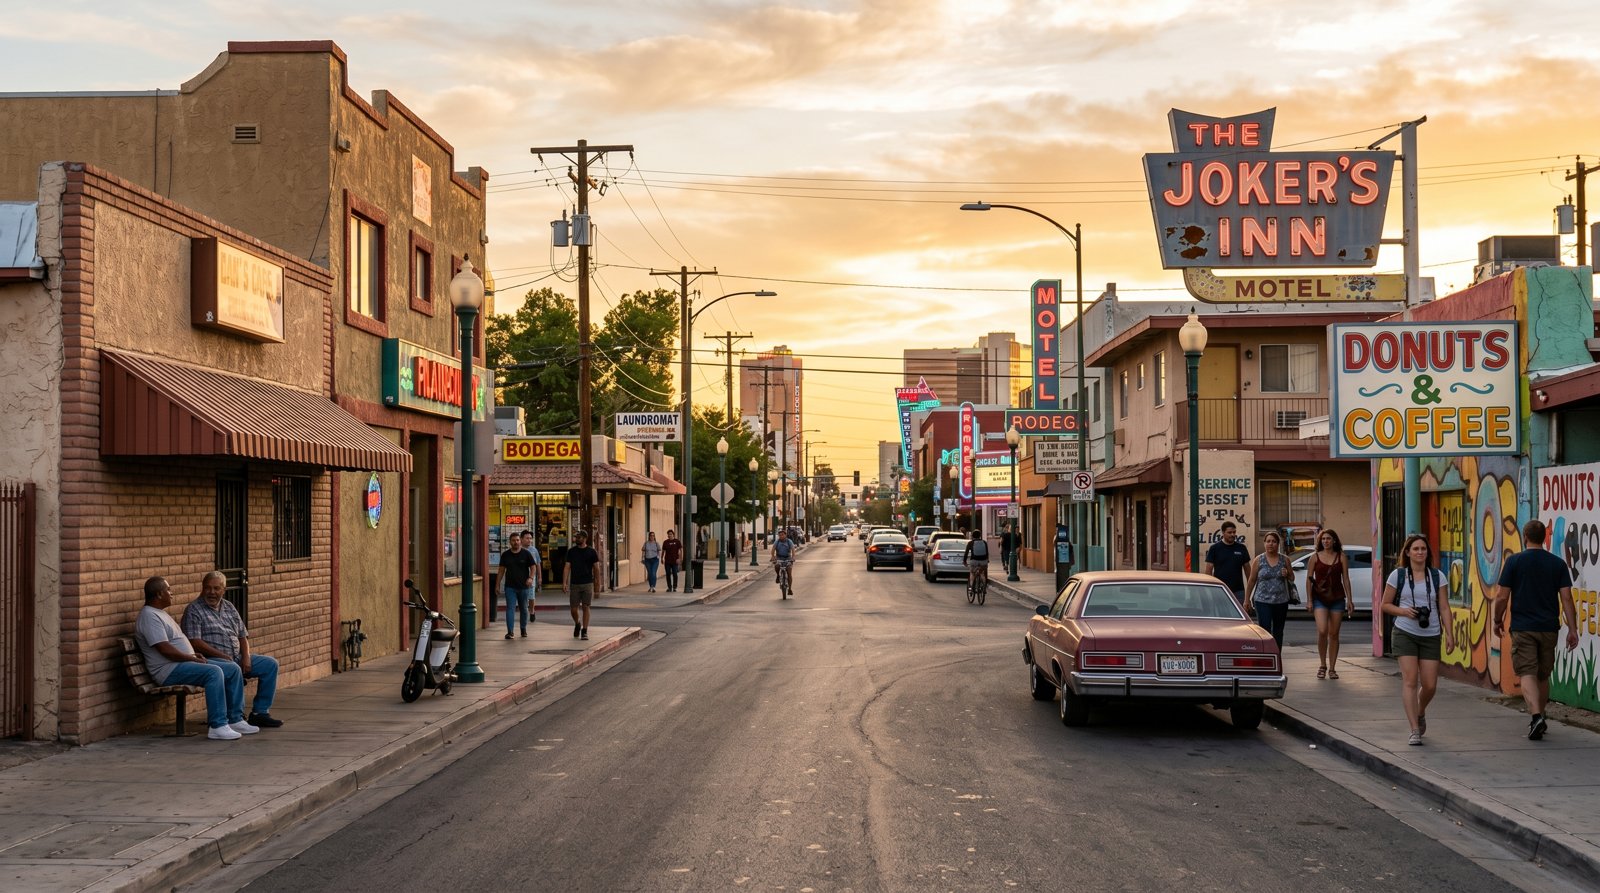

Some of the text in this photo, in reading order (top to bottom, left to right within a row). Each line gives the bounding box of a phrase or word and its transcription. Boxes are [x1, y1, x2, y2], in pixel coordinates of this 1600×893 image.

[1188, 122, 1261, 146] THE
[1163, 155, 1379, 206] JOKER'S
[1218, 216, 1326, 257] INN
[1235, 279, 1331, 298] MOTEL
[1037, 287, 1056, 400] MOTEL
[1342, 329, 1510, 373] DONUTS
[1411, 374, 1442, 405] &
[617, 415, 678, 425] LAUNDROMAT
[1343, 406, 1511, 450] COFFEE
[506, 442, 581, 458] BODEGA
[1543, 472, 1595, 511] DONUTS
